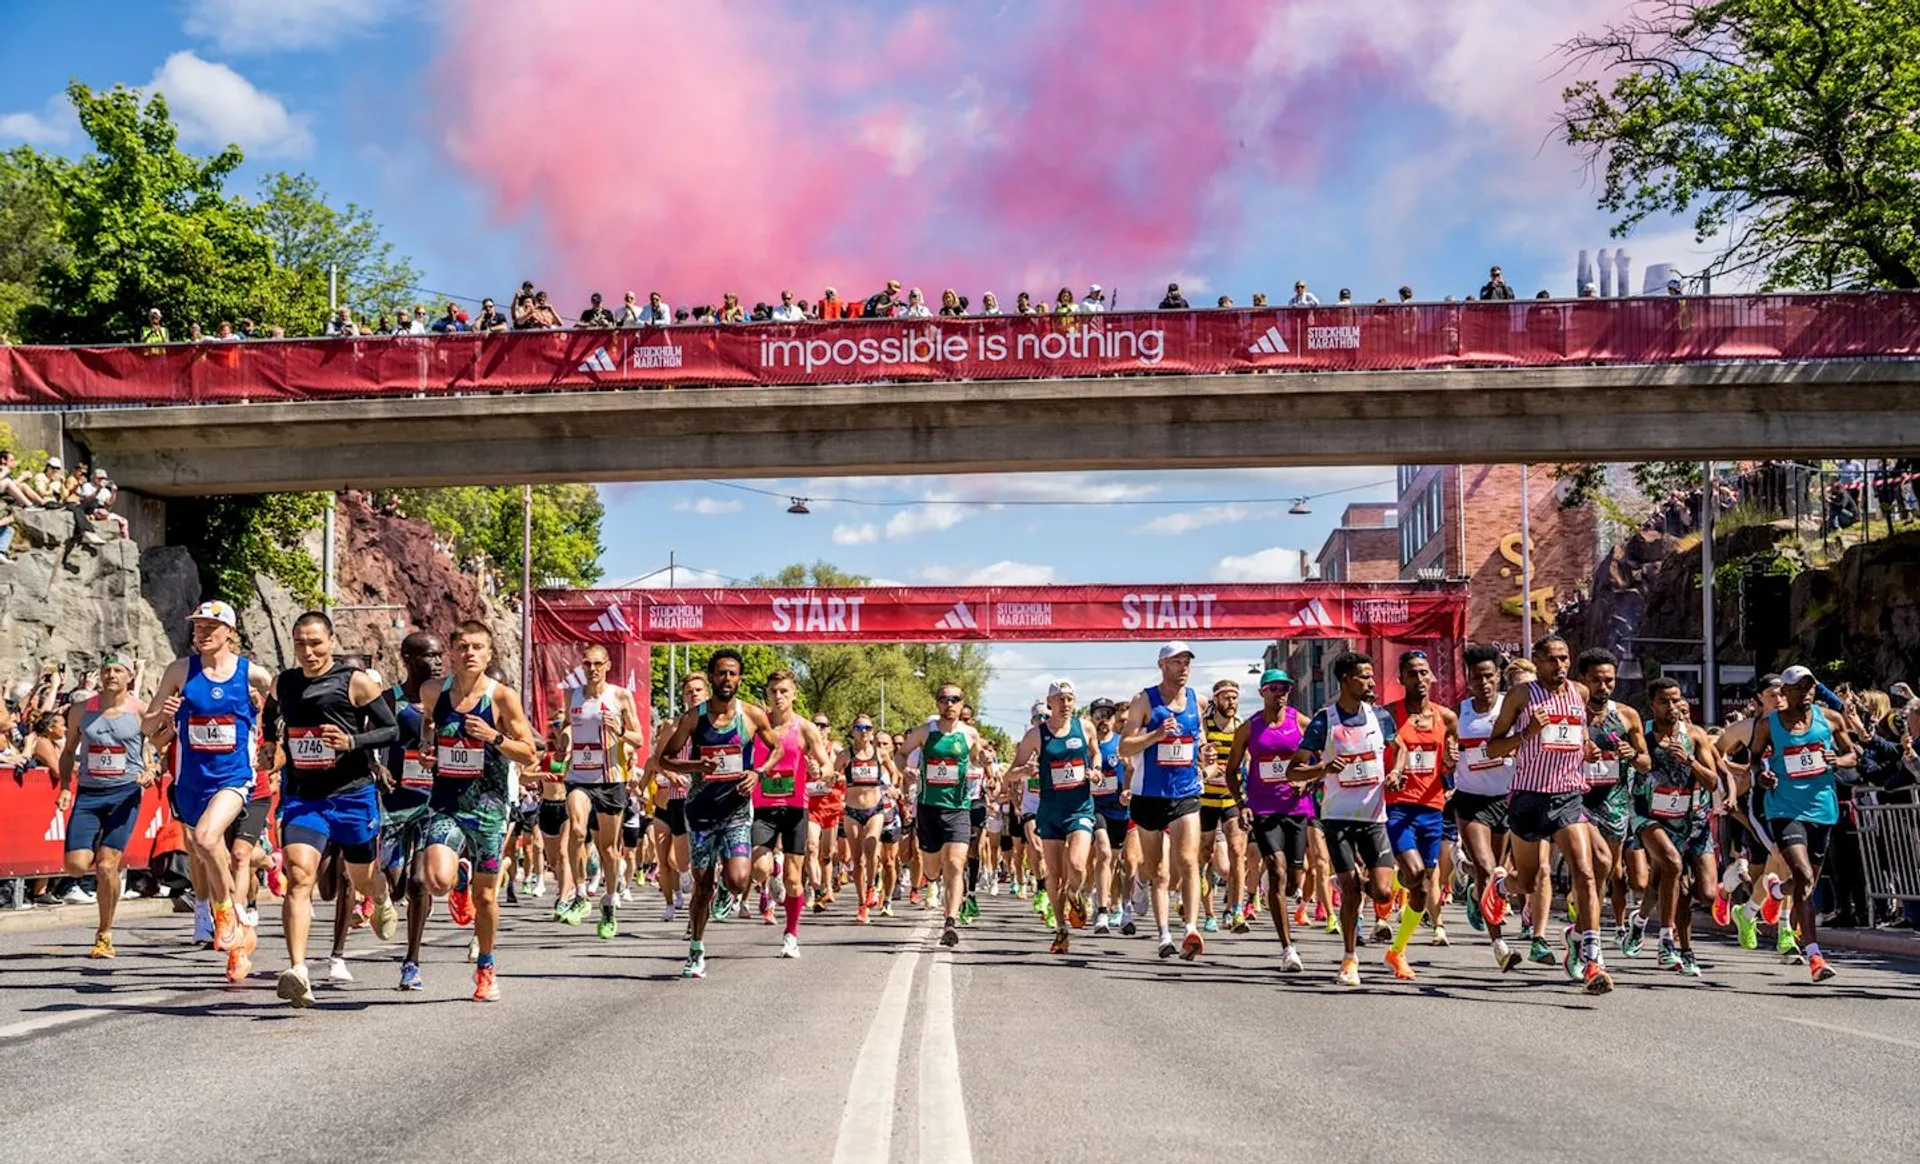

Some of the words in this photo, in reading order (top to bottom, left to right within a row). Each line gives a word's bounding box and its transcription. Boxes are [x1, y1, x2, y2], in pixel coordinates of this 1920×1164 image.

[1307, 326, 1360, 338] STOCKHOLM
[760, 329, 968, 373] impossible
[978, 333, 1008, 362] is
[1017, 323, 1164, 365] nothing
[1307, 336, 1360, 349] MARATHON
[633, 345, 682, 358] STOCKHOLM
[633, 355, 682, 368] MARATHON
[649, 604, 703, 618] STOCKHOLM
[996, 602, 1052, 615] STOCKHOLM
[1121, 593, 1217, 630] START
[1352, 599, 1409, 613] STOCKHOLM
[772, 596, 865, 632] START
[996, 614, 1052, 627] MARATHON
[1352, 611, 1409, 624] MARATHON
[649, 616, 703, 629] MARATHON
[1491, 640, 1520, 652] Svea
[207, 727, 218, 739] 14
[1558, 726, 1568, 739] 12
[297, 740, 323, 754] 2746
[1173, 745, 1181, 756] 17
[450, 749, 468, 764] 100
[583, 751, 592, 761] 30
[1415, 753, 1421, 763] 9
[1800, 754, 1813, 767] 83
[937, 766, 947, 776] 20
[1064, 768, 1075, 779] 24
[1355, 764, 1363, 775] 5
[1670, 797, 1677, 808] 2
